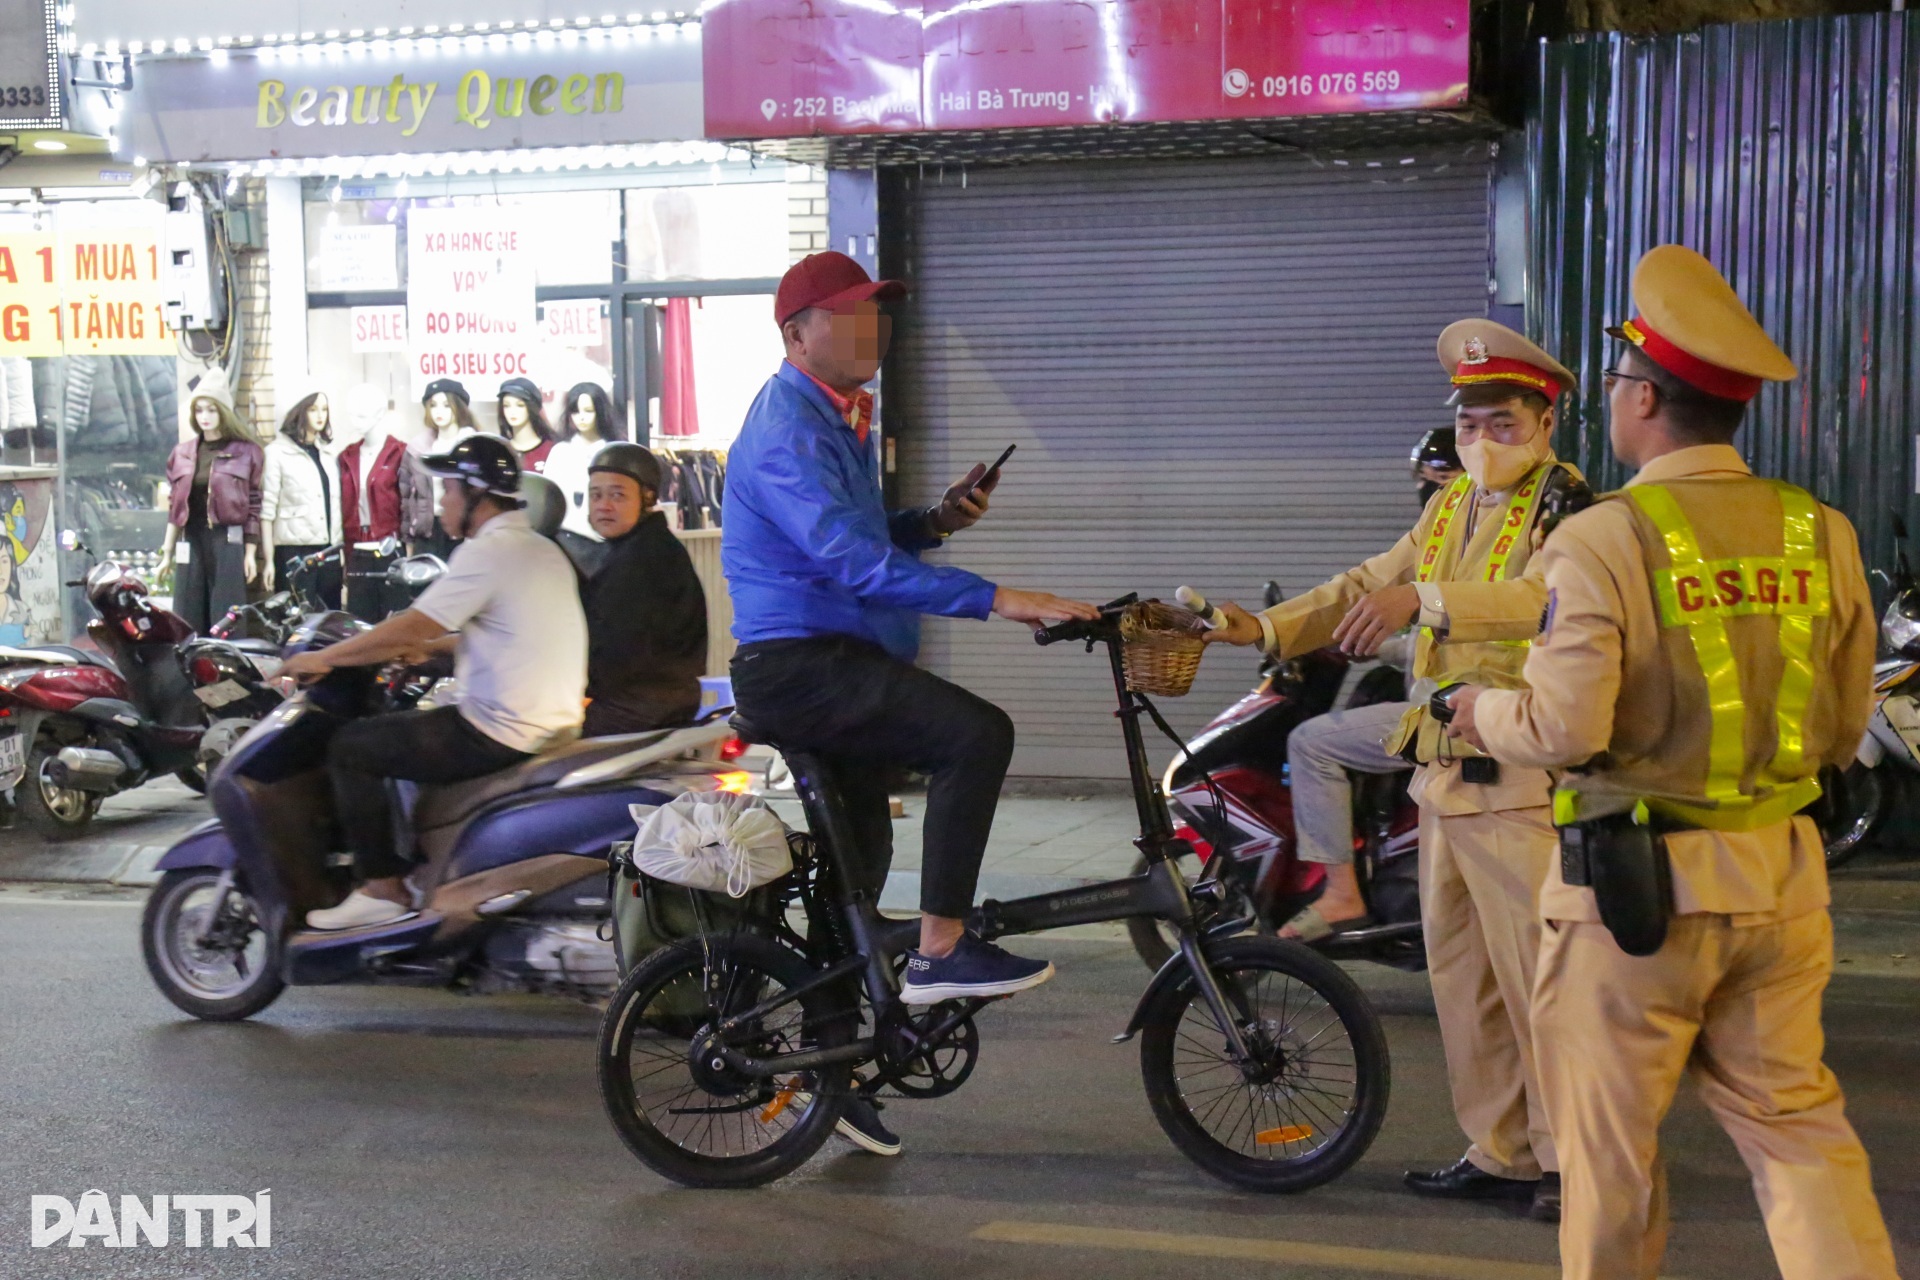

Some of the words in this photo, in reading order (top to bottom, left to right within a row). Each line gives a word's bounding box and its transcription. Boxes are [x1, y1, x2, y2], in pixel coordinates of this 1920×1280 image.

[1263, 75, 1313, 98] 0916
[1319, 72, 1357, 94] 076
[1362, 70, 1400, 92] 569
[255, 73, 438, 136] Beauty
[454, 69, 625, 129] Queen
[793, 97, 827, 118] 252
[939, 91, 971, 111] Hai
[978, 89, 1004, 110] Bà
[1009, 88, 1070, 111] Trưng
[36, 246, 53, 283] 1
[75, 243, 137, 281] MUA
[147, 244, 157, 281] 1
[49, 305, 62, 341] 1
[69, 294, 144, 348] TẶNG
[356, 314, 404, 342] SALE
[549, 307, 598, 336] SALE
[1676, 567, 1813, 612] C.S.G.T
